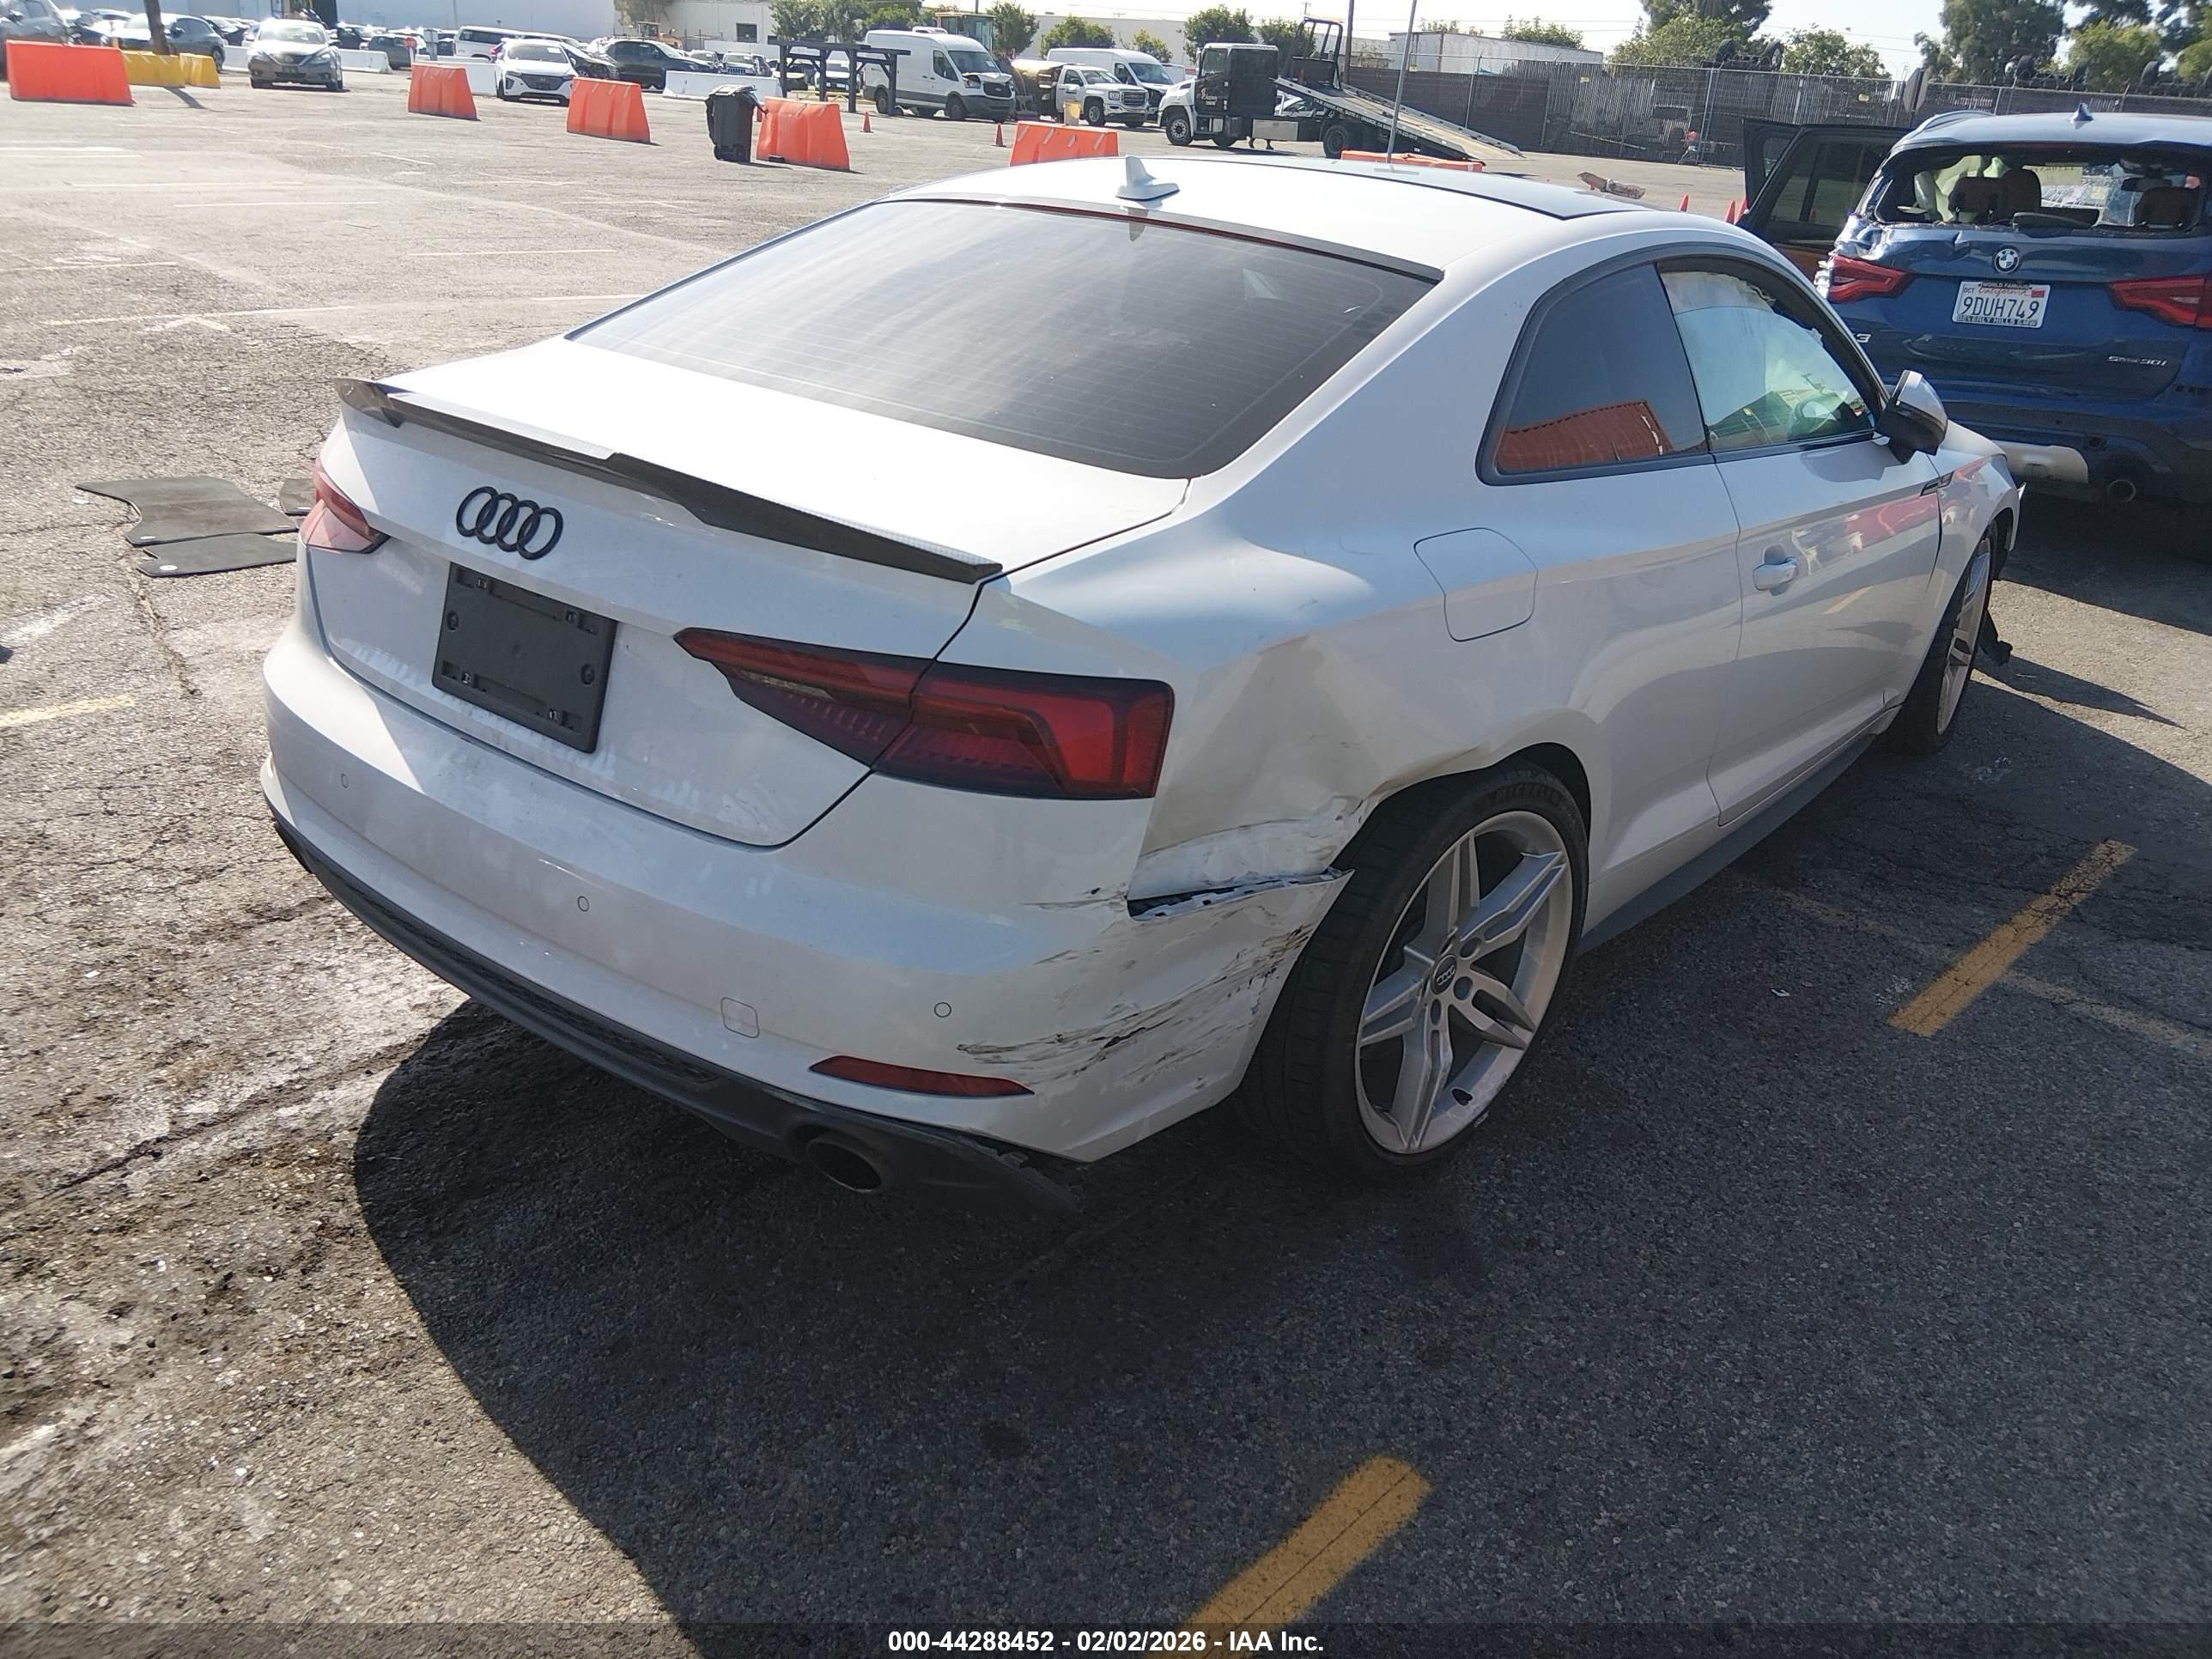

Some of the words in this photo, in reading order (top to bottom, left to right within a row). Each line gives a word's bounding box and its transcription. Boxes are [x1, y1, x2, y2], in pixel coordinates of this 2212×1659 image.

[1978, 286, 2032, 297] California
[1960, 296, 2040, 319] 9DUH749
[1957, 314, 1990, 323] BEVERLY
